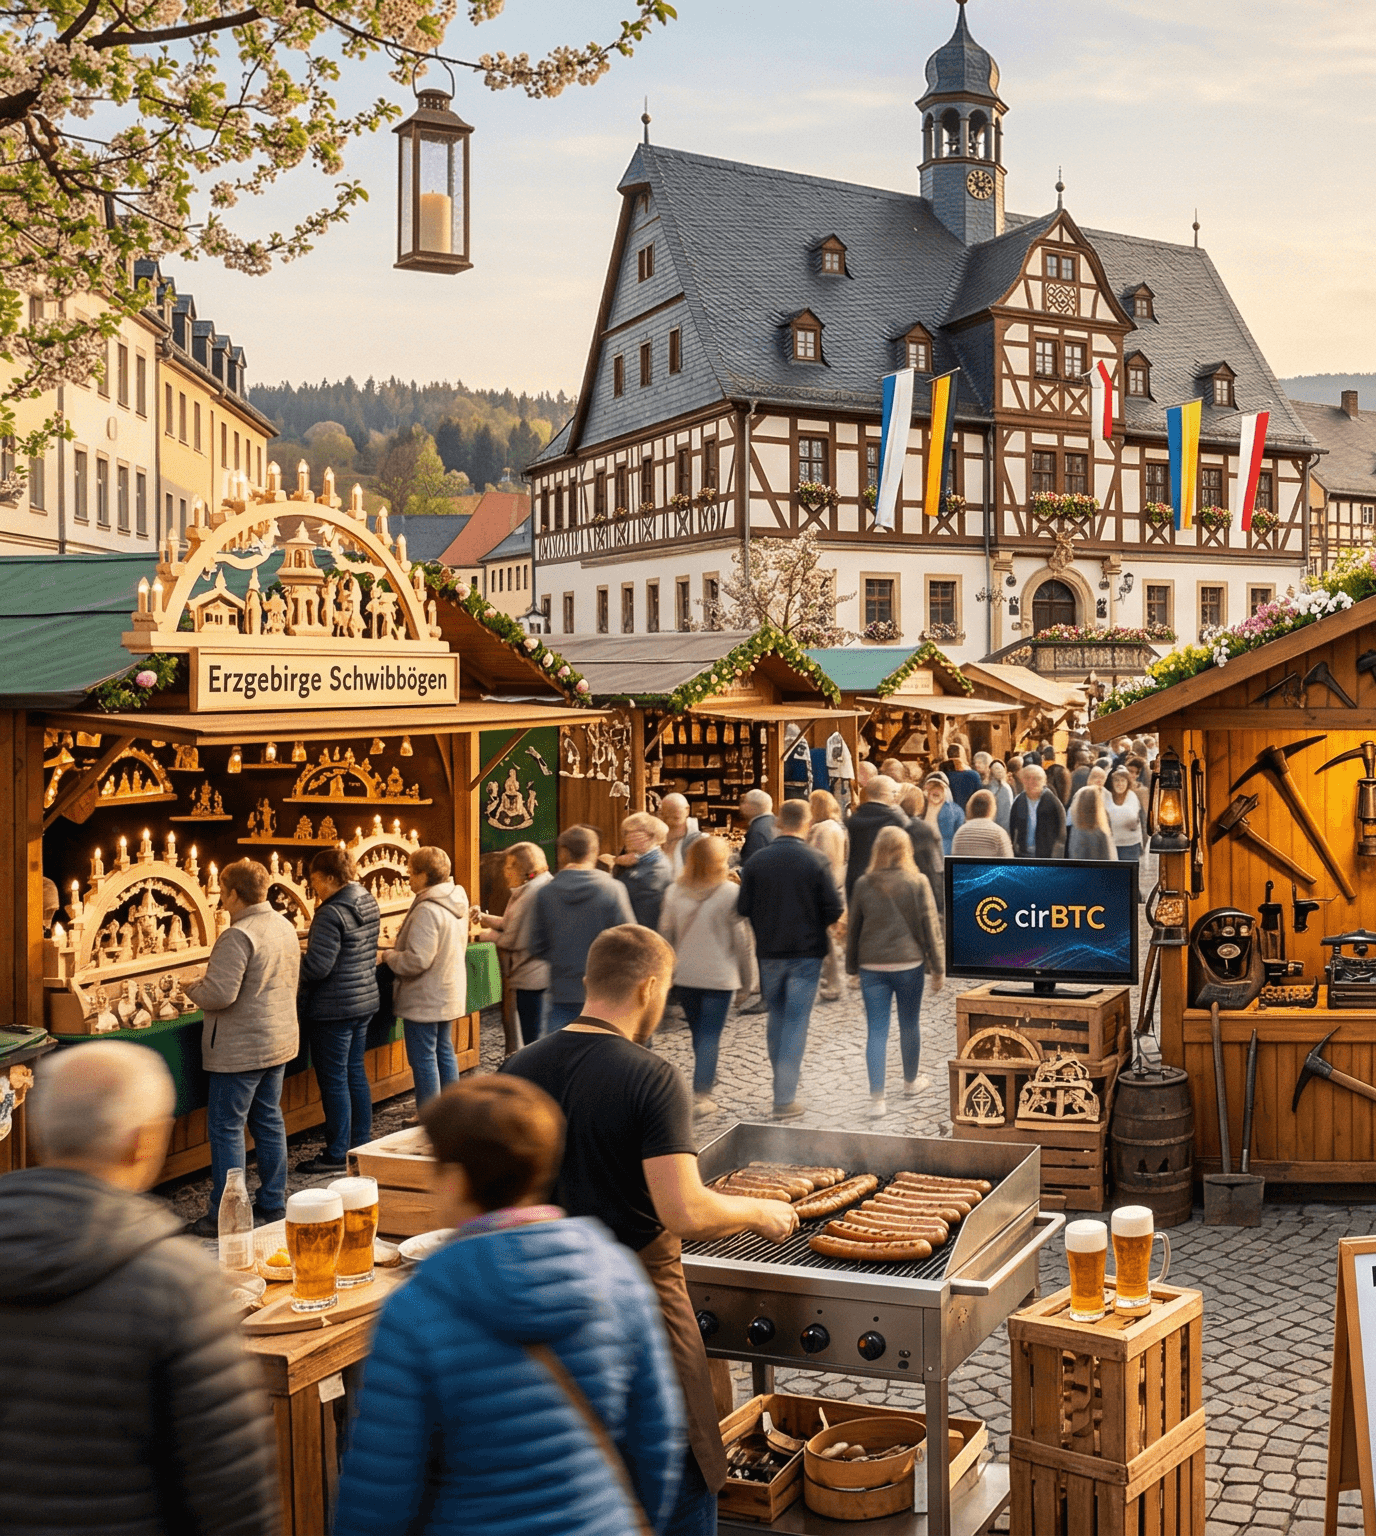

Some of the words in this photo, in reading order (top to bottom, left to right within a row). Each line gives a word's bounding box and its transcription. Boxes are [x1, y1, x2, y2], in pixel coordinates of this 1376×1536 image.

[209, 664, 322, 700] Erzgebirge
[329, 665, 448, 697] Schwibbögen
[1014, 903, 1106, 930] cirBTC
